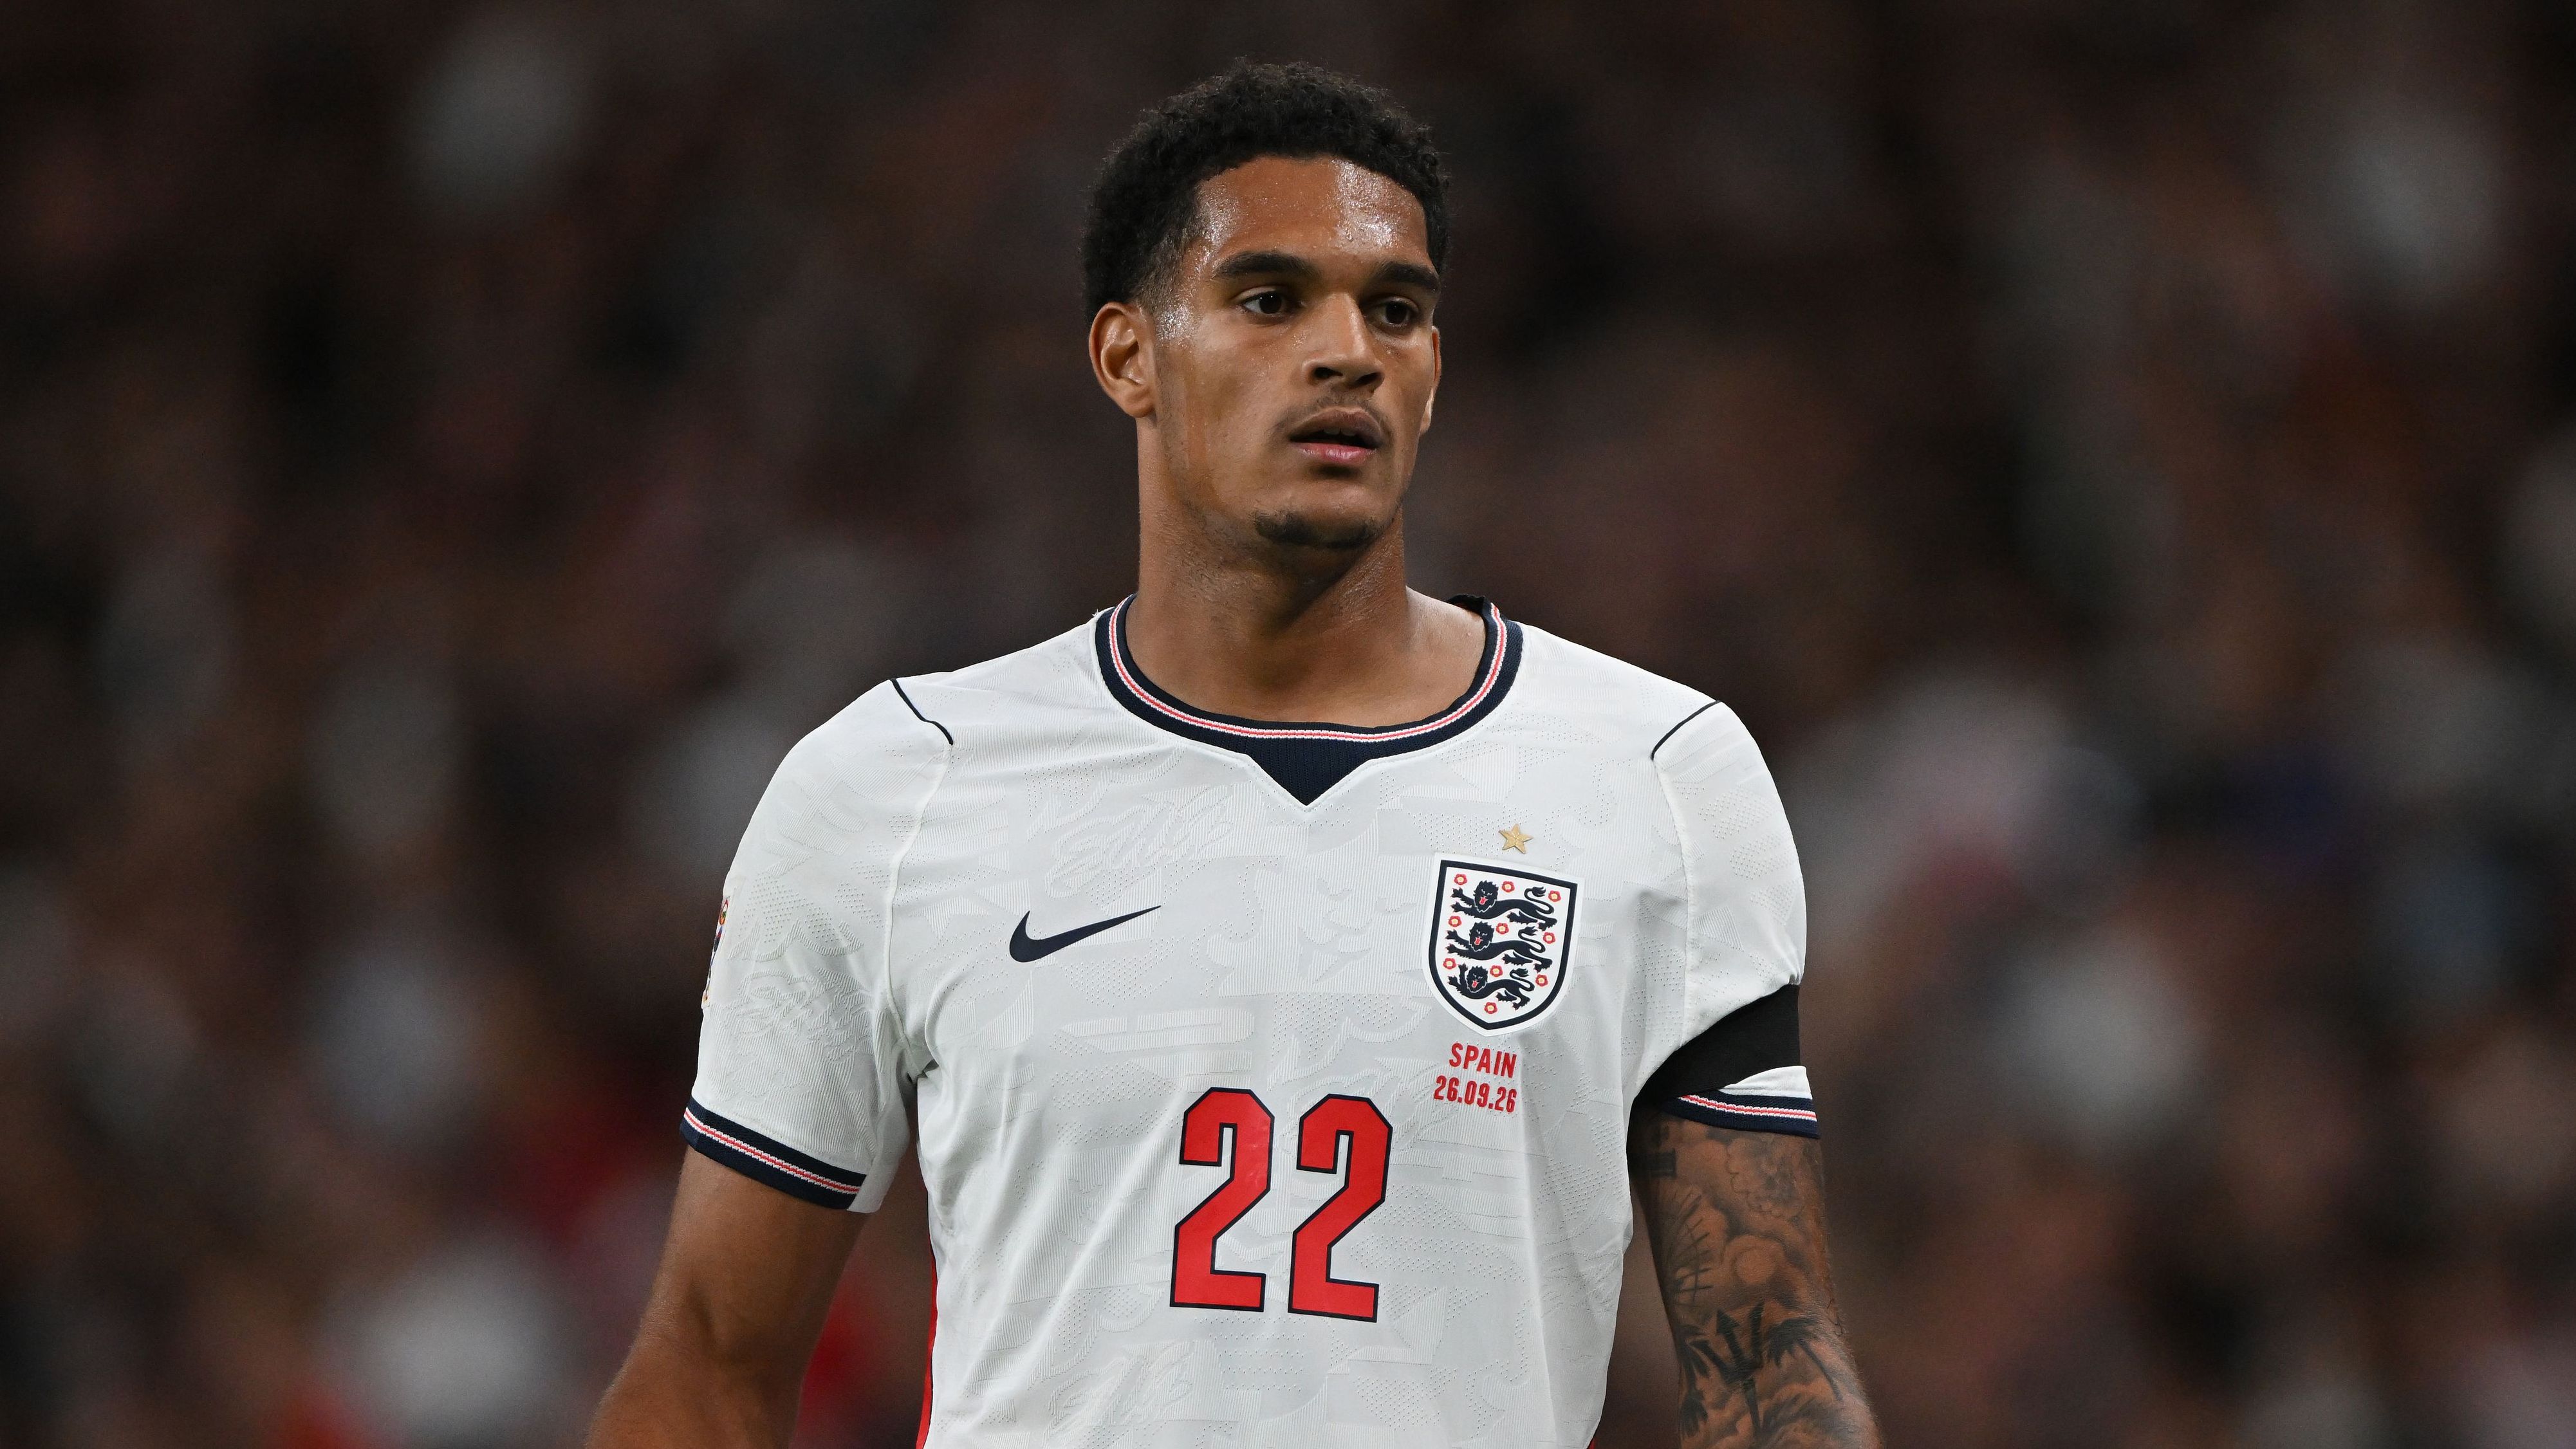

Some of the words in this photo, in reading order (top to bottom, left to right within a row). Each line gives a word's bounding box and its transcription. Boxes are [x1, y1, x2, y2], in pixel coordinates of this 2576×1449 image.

[1449, 1042, 1517, 1078] SPAIN
[1433, 1075, 1517, 1113] 26.09.26
[1170, 1087, 1393, 1323] 22
